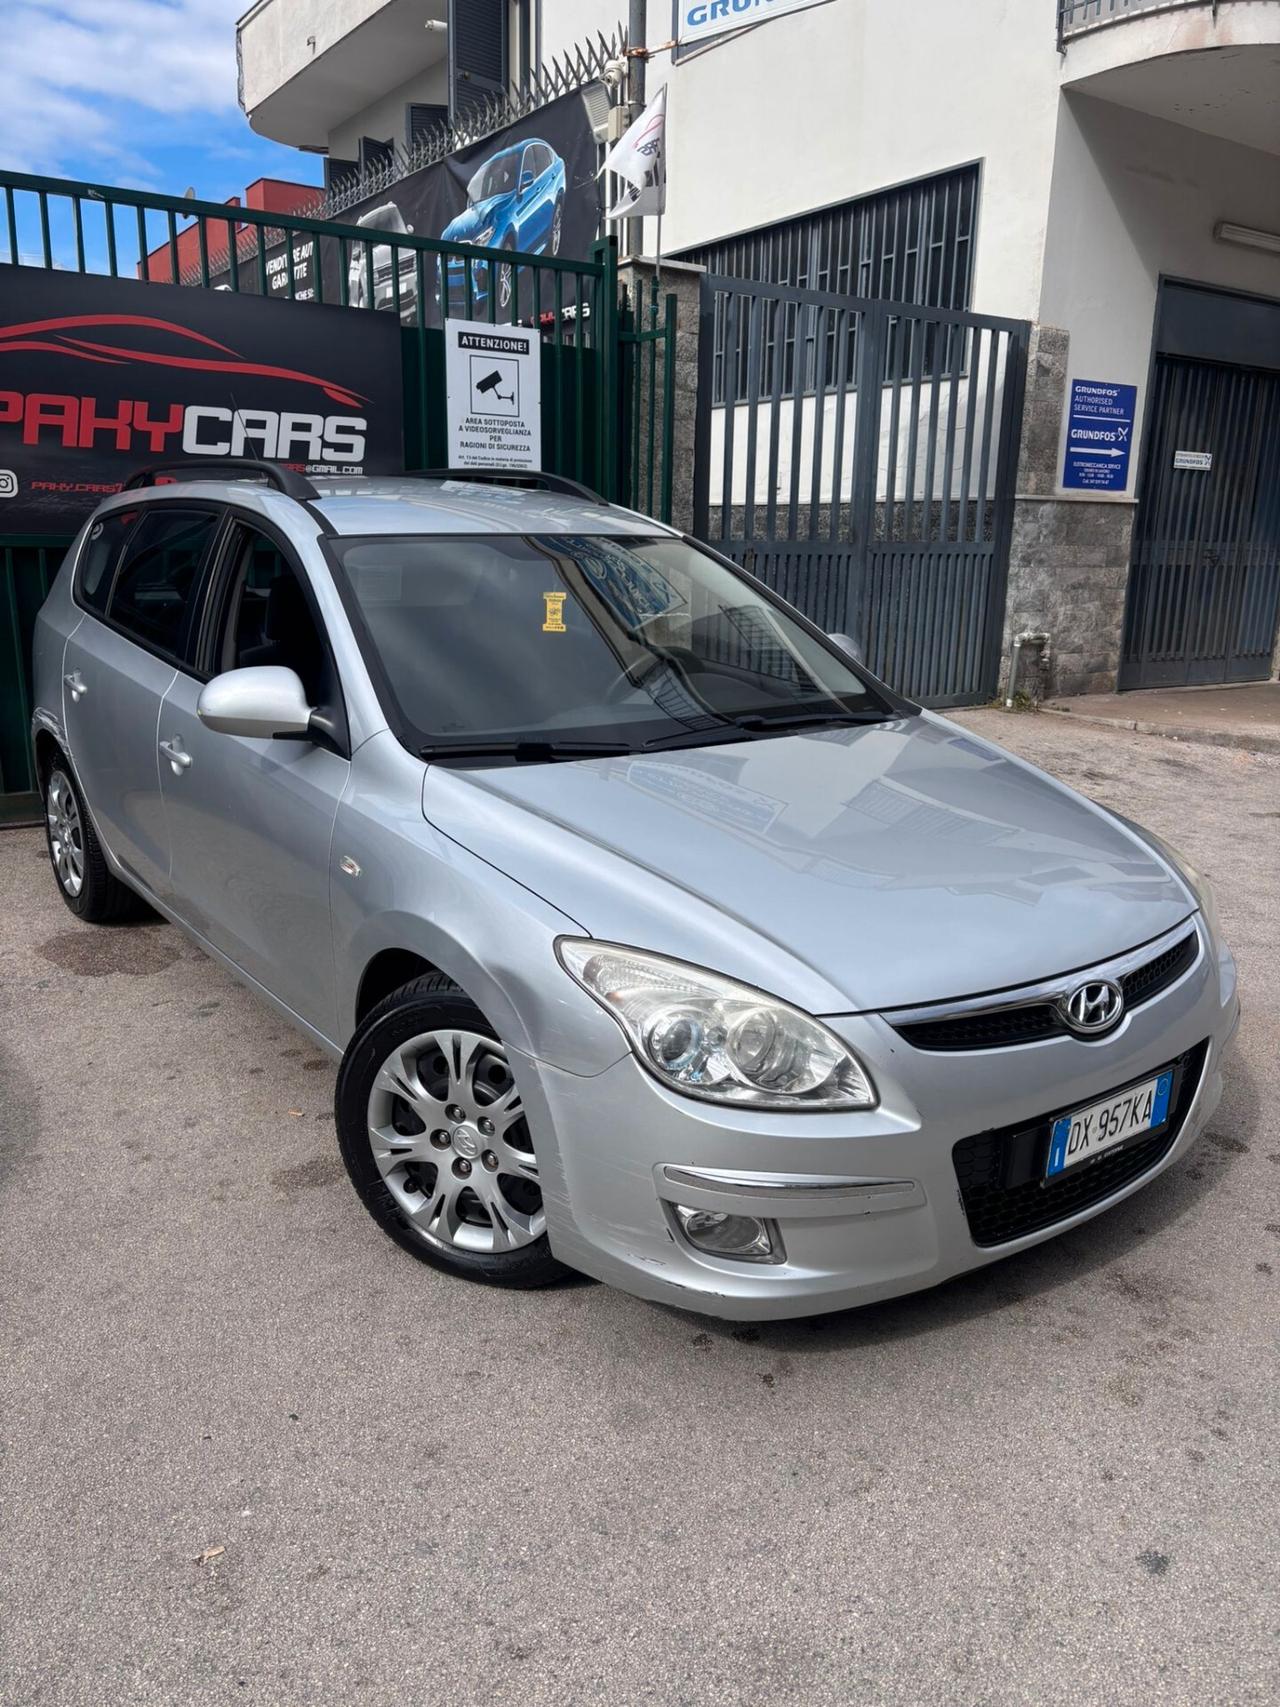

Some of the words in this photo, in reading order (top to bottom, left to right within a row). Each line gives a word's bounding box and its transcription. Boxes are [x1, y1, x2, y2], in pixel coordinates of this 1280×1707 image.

[265, 247, 301, 276] VENDITRE
[461, 335, 527, 352] ATTENZIONE!
[1075, 385, 1118, 397] GRUNDFOS
[1074, 395, 1113, 406] AUTHORISED
[1073, 403, 1098, 413] SERVICE
[1099, 406, 1124, 415] PARTNER
[465, 417, 483, 426] AREA
[484, 418, 526, 428] SOTTOPOSTA
[465, 425, 532, 437] VIDEOSORVEGLIANZA
[1071, 428, 1116, 442] GRUNDFOS
[489, 434, 502, 442] PER
[460, 441, 487, 449] RAGIONI
[488, 442, 495, 450] DI
[496, 443, 531, 452] SICUREZZA
[1068, 1114, 1093, 1155] DX
[1098, 1090, 1153, 1142] 957KA
